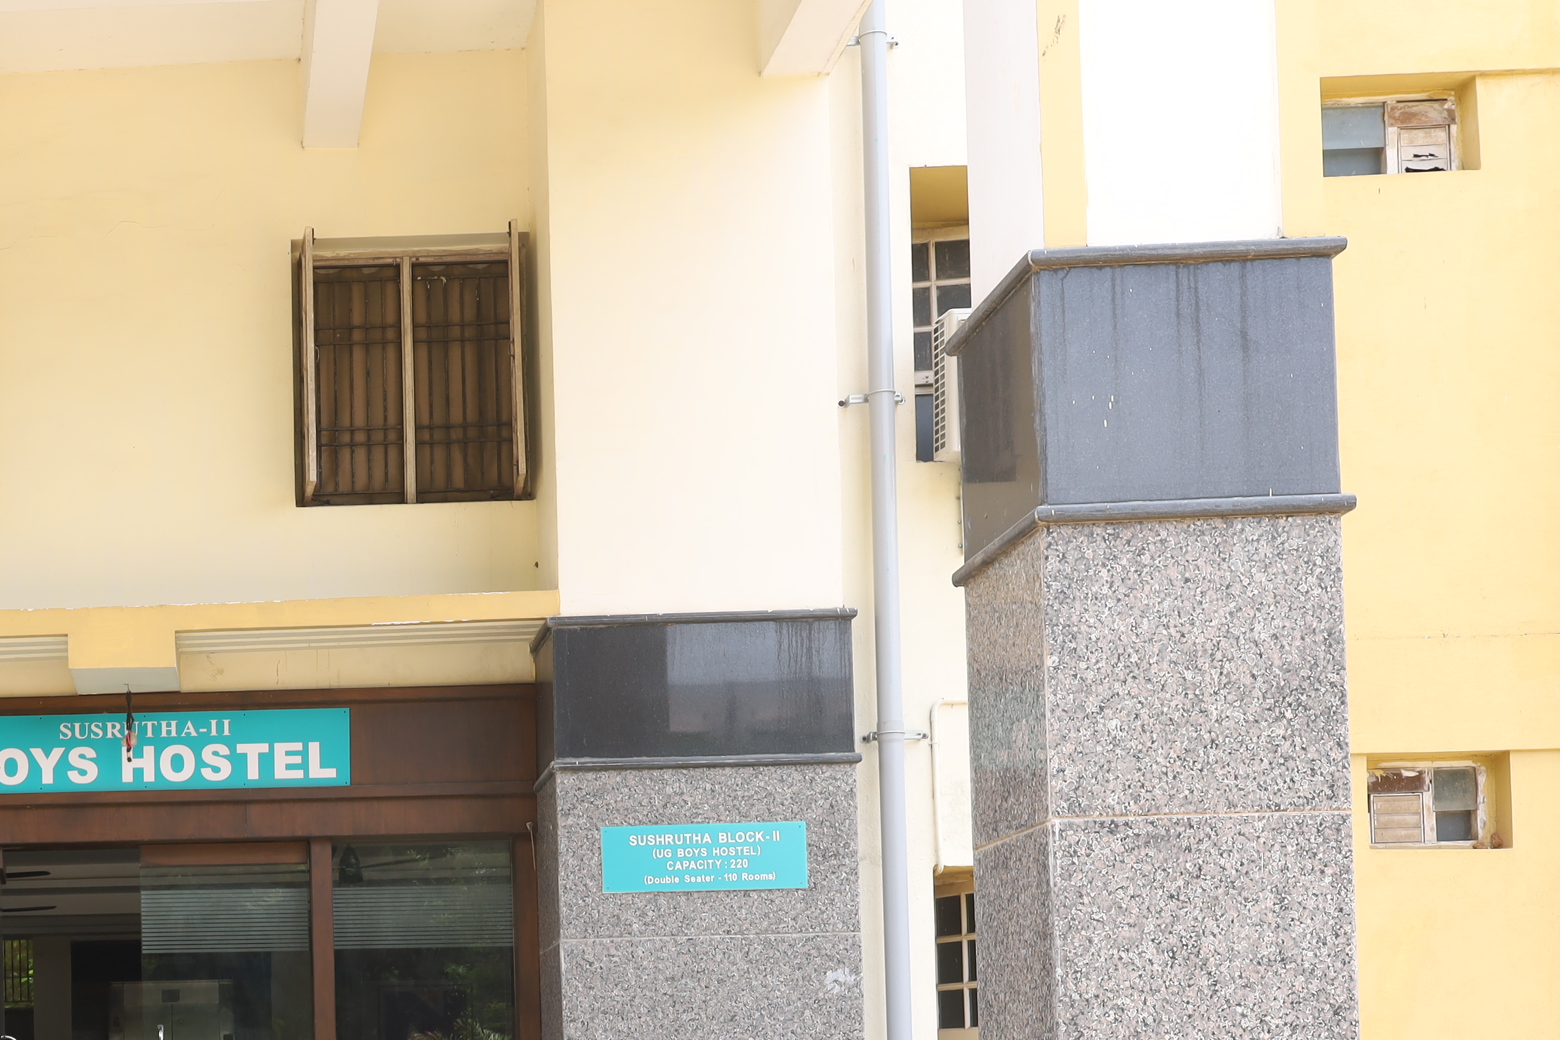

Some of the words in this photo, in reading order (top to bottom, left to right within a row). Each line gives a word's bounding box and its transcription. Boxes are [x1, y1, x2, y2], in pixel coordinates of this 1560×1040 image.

[121, 741, 338, 783] HOSTEL
[629, 833, 712, 846] SUSHRUTHA
[652, 848, 673, 860] (UG
[677, 847, 708, 858] BOYS
[712, 845, 761, 857] HOSTEL)
[666, 859, 722, 871] CAPACITY
[730, 858, 749, 869] 220
[644, 874, 680, 885] (Double
[684, 873, 715, 883] Seater
[724, 872, 738, 882] 110
[742, 871, 776, 881] Rooms)
